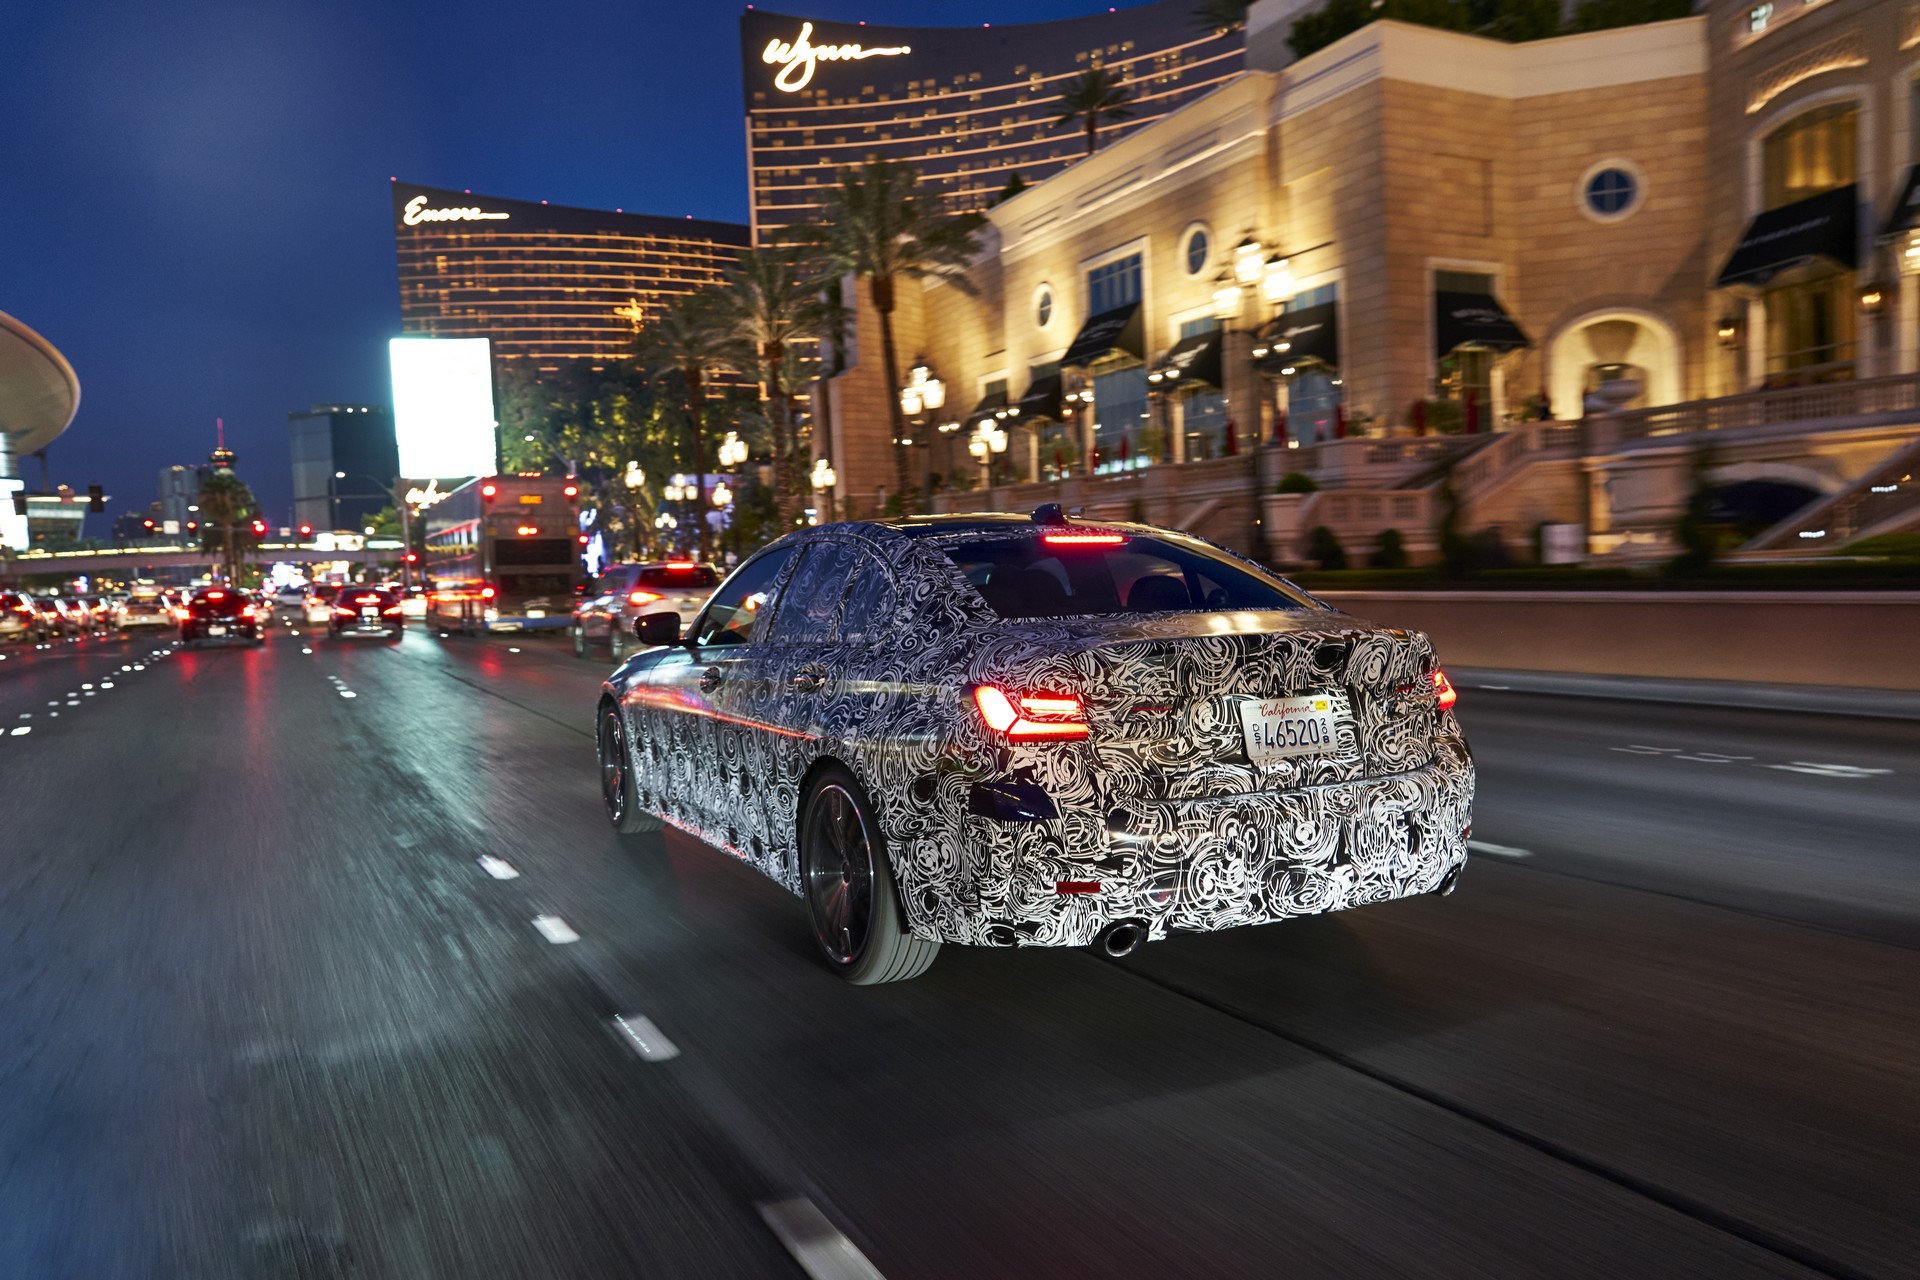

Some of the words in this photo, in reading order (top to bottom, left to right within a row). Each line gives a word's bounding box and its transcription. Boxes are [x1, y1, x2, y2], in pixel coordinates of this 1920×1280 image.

[403, 195, 510, 226] Encore
[1261, 702, 1315, 719] California
[1264, 718, 1319, 749] 46520
